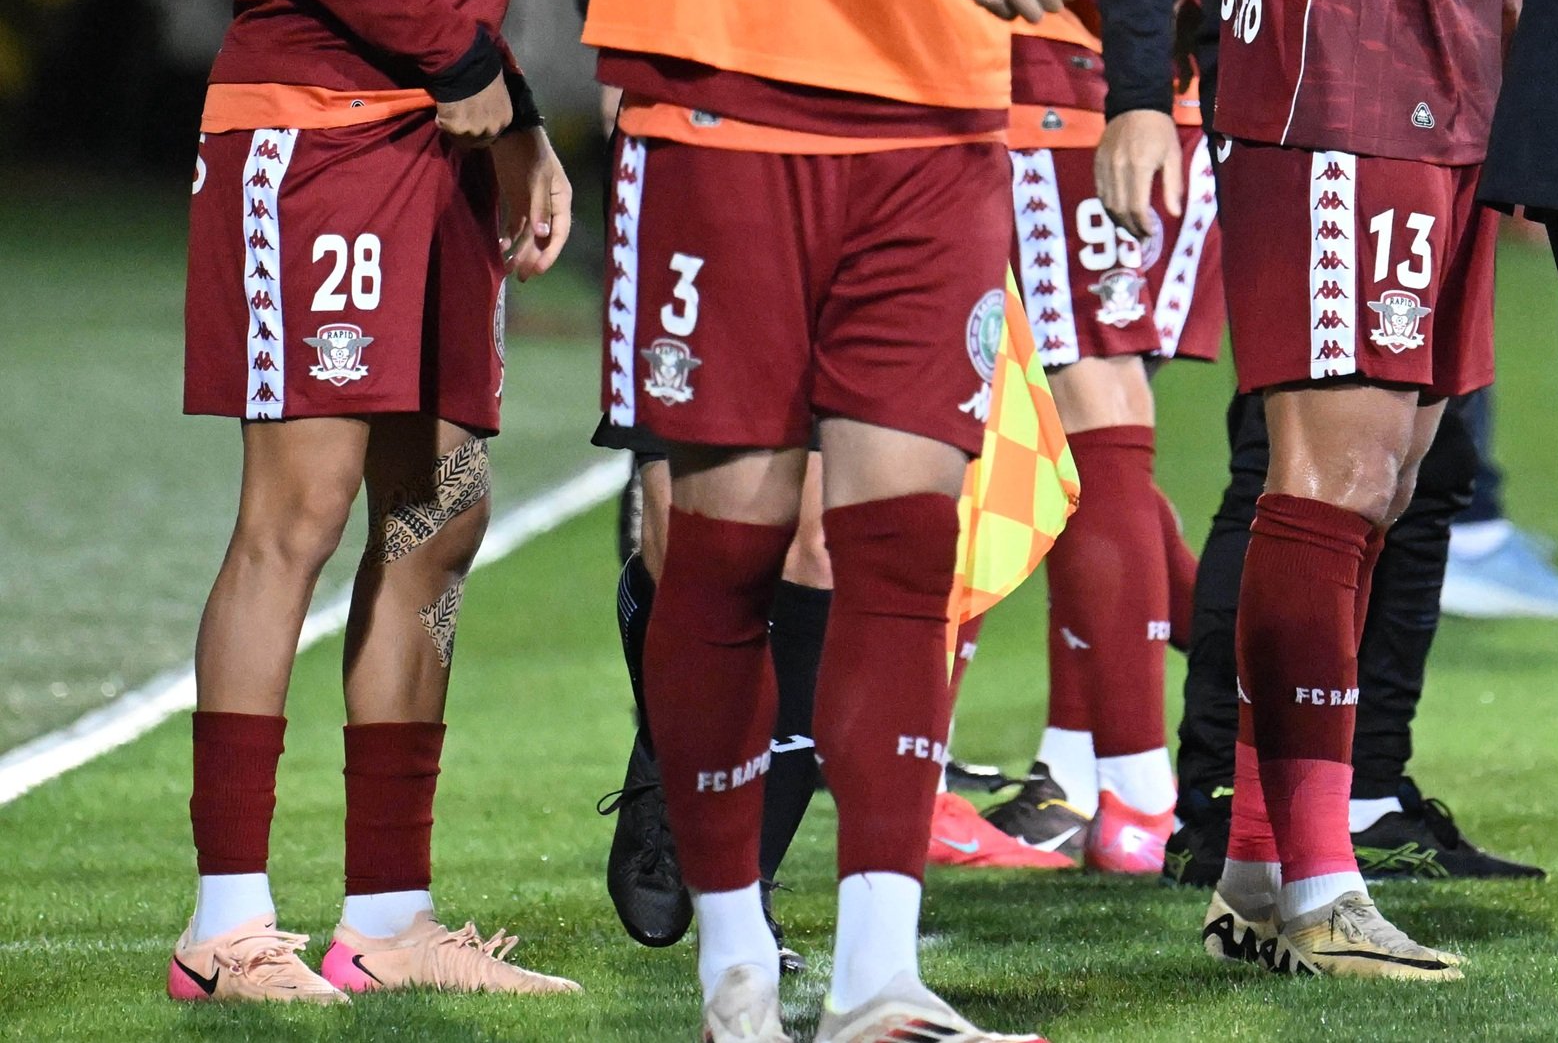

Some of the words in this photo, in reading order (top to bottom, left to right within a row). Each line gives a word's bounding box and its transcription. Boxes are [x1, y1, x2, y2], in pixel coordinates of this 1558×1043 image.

[1368, 208, 1437, 290] 13
[310, 232, 383, 312] 28
[660, 252, 705, 337] 3
[1389, 296, 1413, 307] RAPID
[326, 331, 354, 340] RAPID
[1295, 686, 1326, 706] FC
[897, 735, 929, 759] FC
[697, 771, 728, 793] FC
